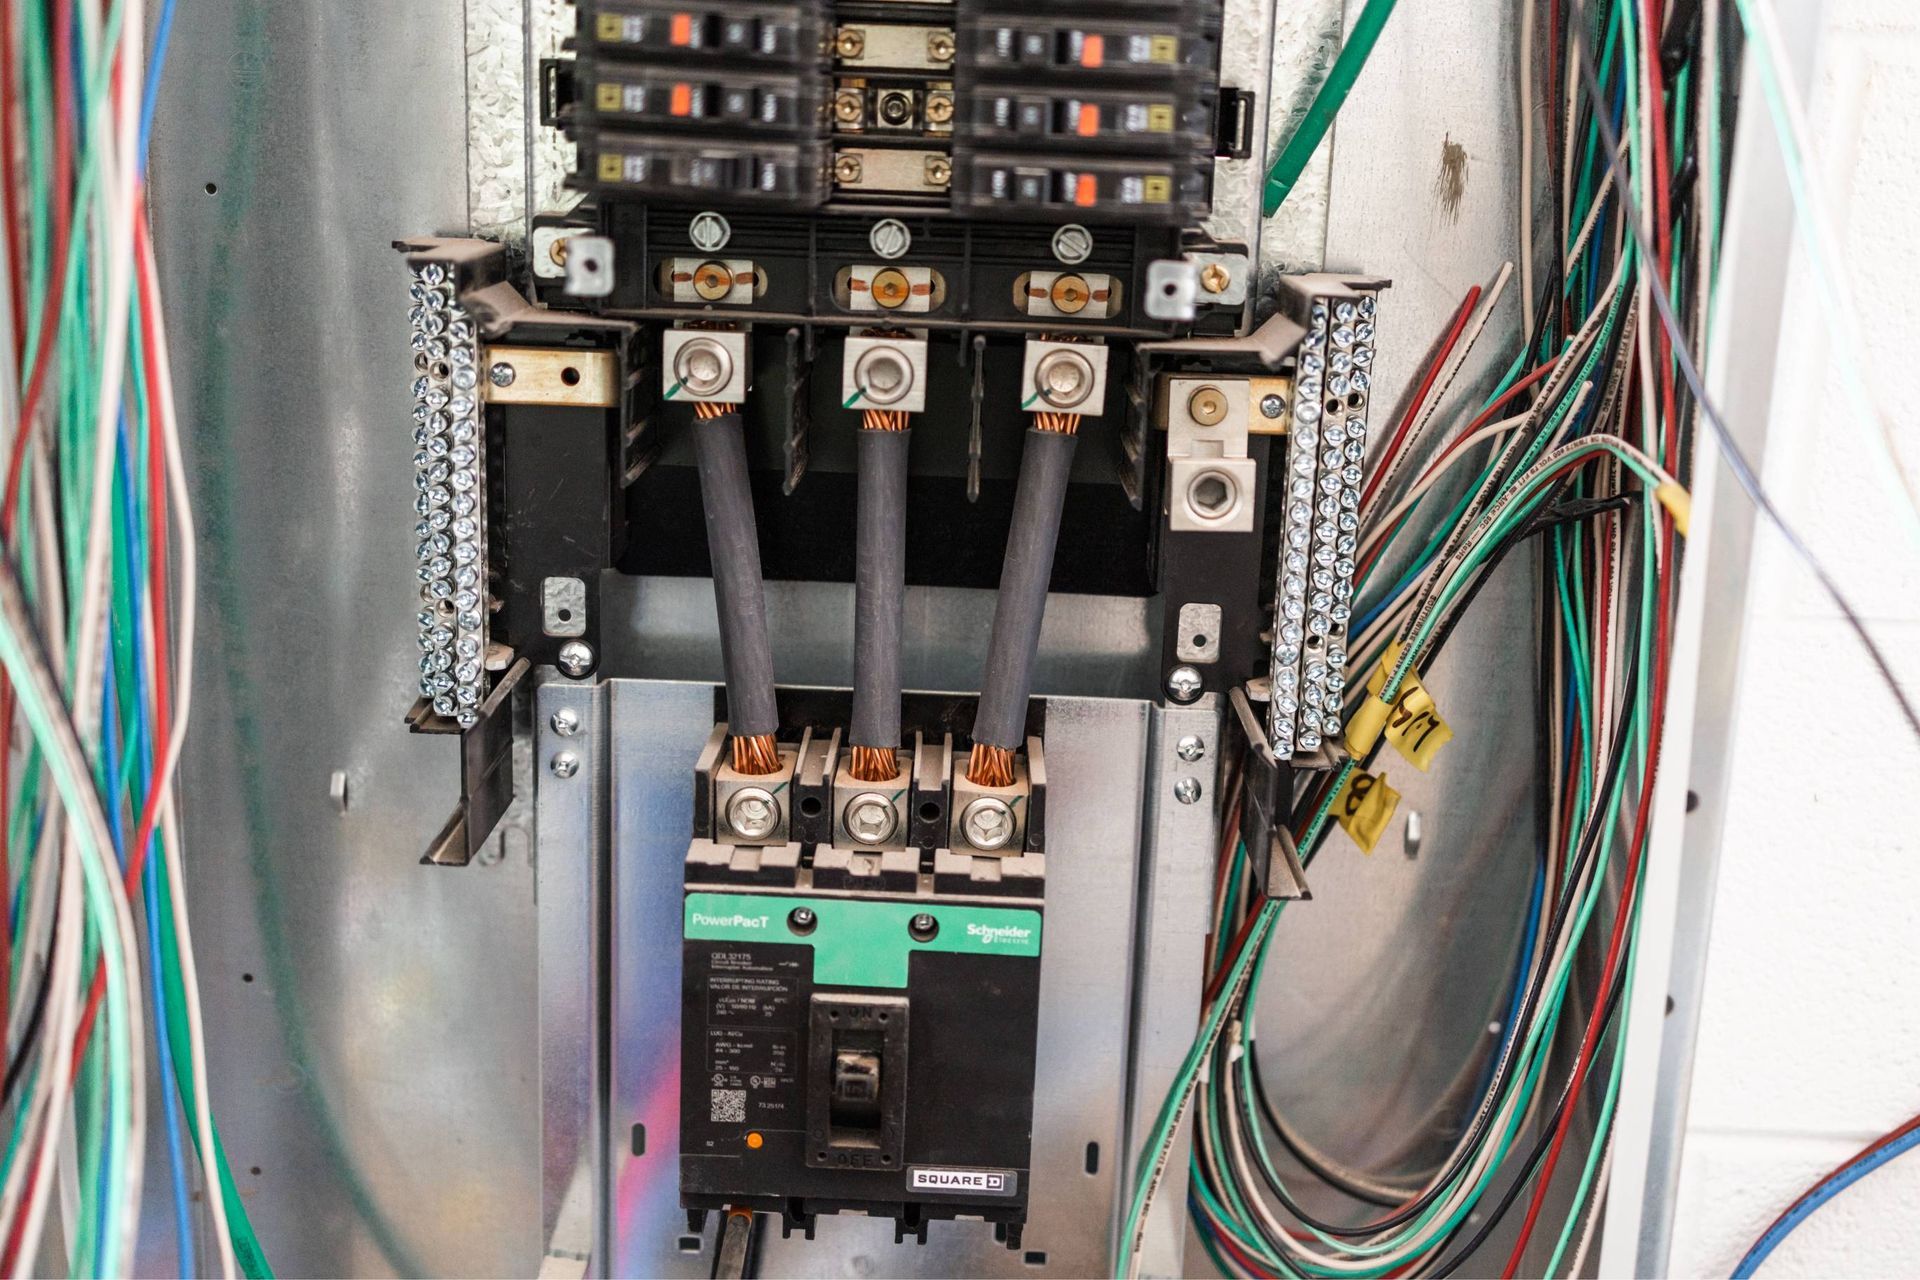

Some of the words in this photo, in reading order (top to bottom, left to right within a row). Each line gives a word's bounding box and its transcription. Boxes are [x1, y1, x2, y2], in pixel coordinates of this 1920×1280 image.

[692, 913, 769, 928] PowerPacT
[966, 923, 1032, 941] Schneider
[917, 1174, 983, 1186] SQUARE
